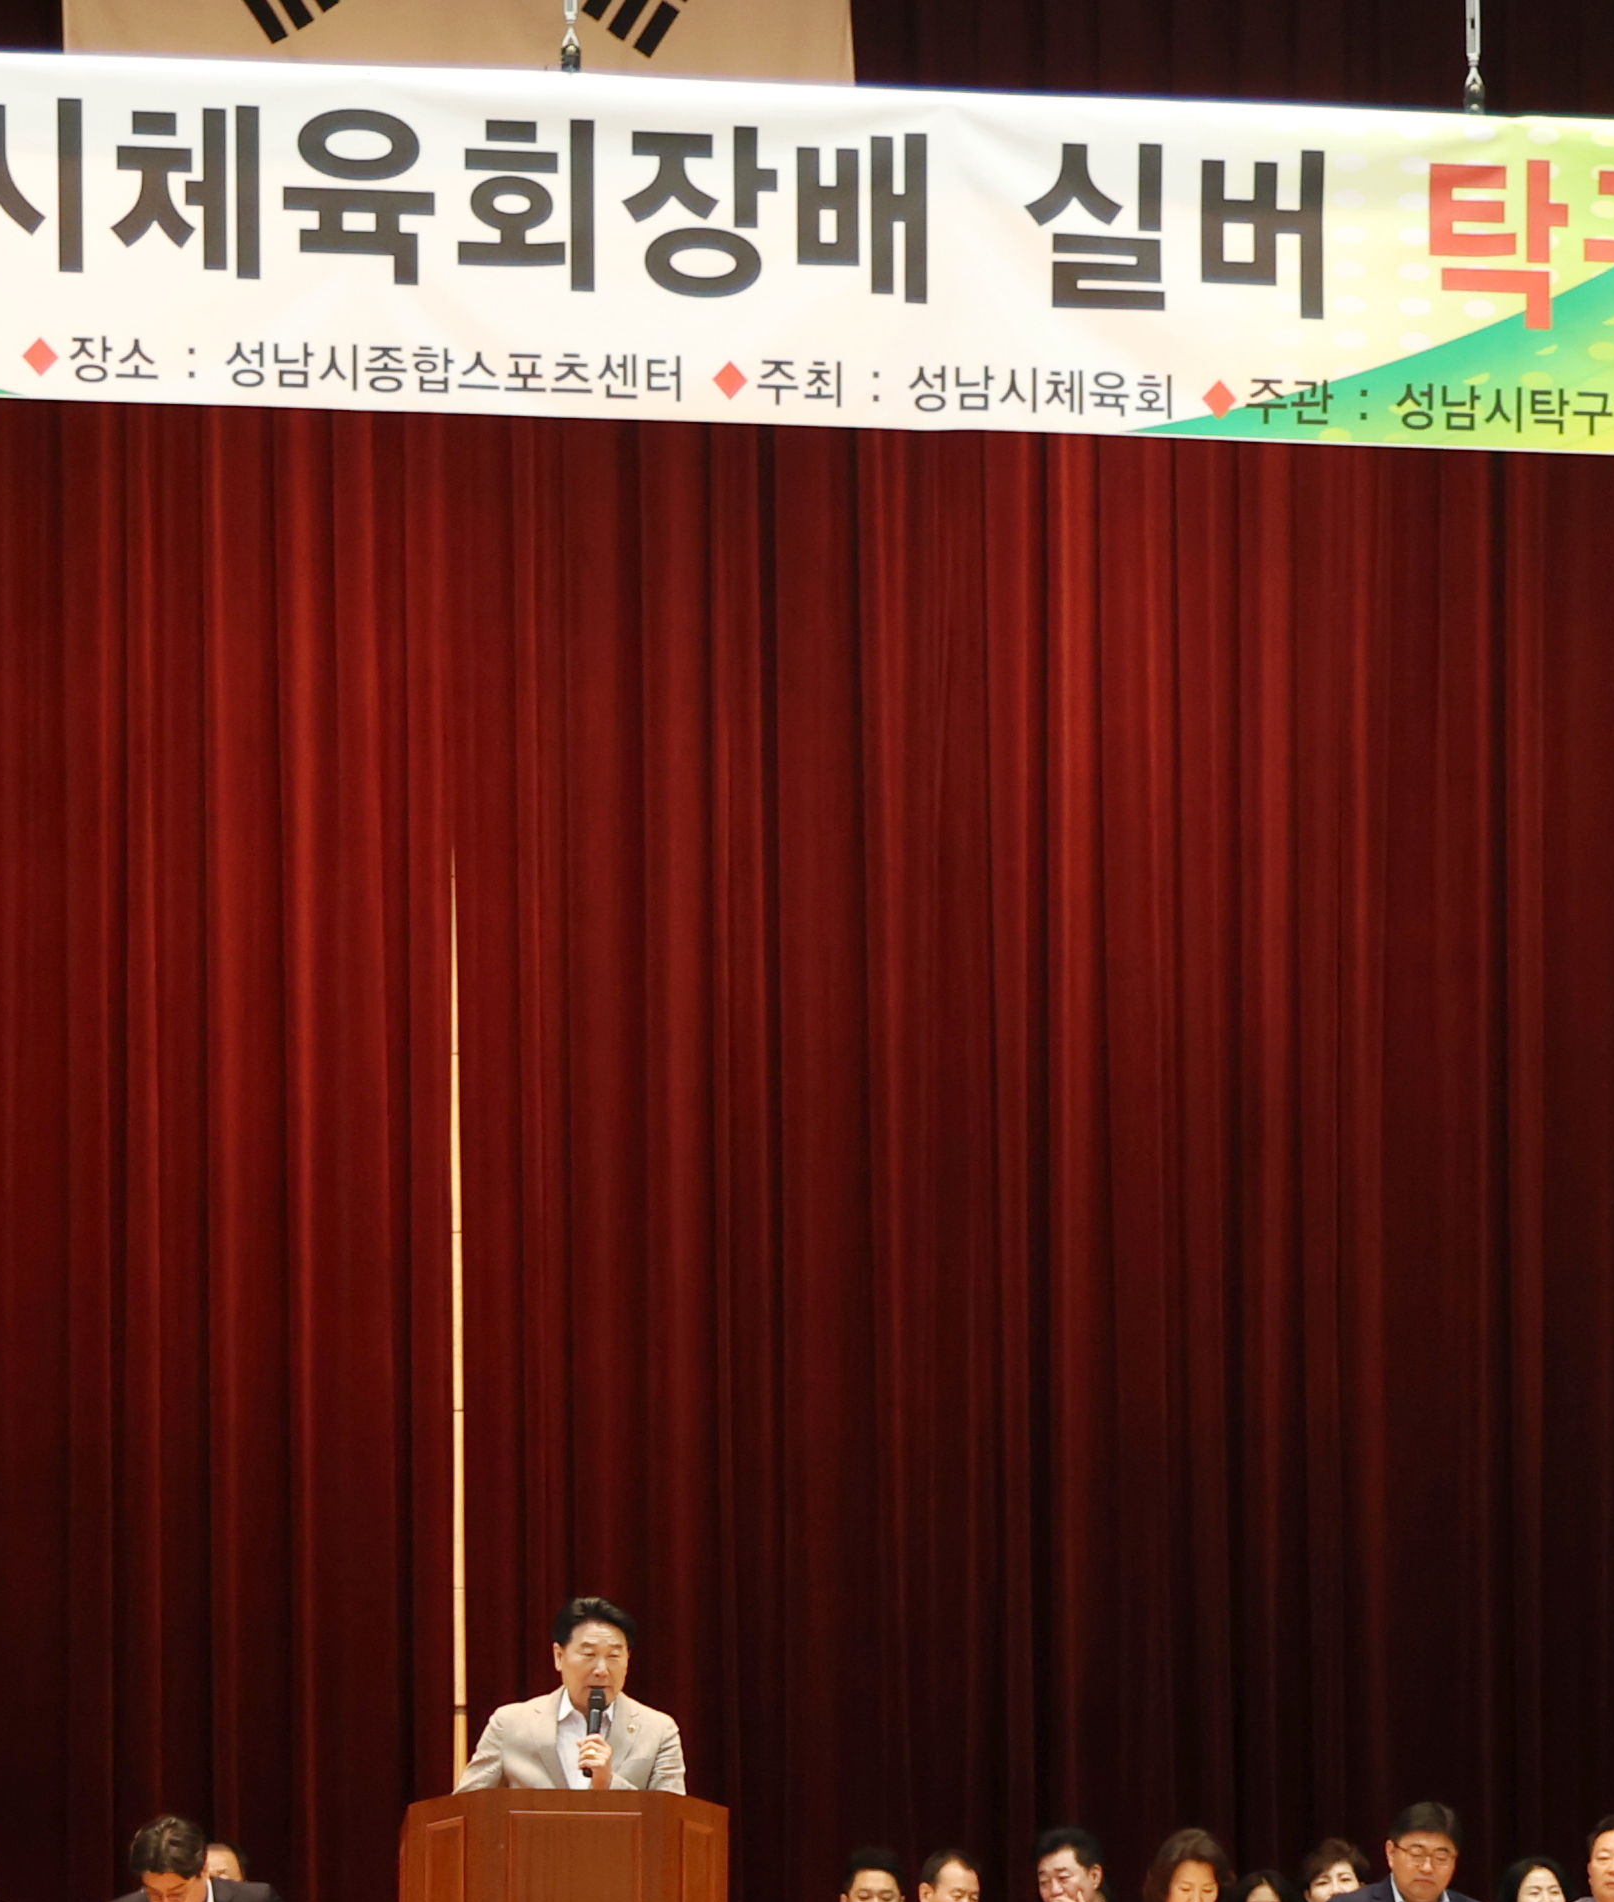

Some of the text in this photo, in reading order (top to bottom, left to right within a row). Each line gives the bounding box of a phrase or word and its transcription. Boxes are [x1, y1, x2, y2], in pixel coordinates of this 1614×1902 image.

[1023, 142, 1326, 321] 실버
[69, 335, 160, 383] 장소
[225, 340, 684, 402] 성남시종합스포츠센터
[757, 360, 843, 408] 주최
[908, 364, 1174, 420] 성남시체육회
[1245, 377, 1335, 427] 주관
